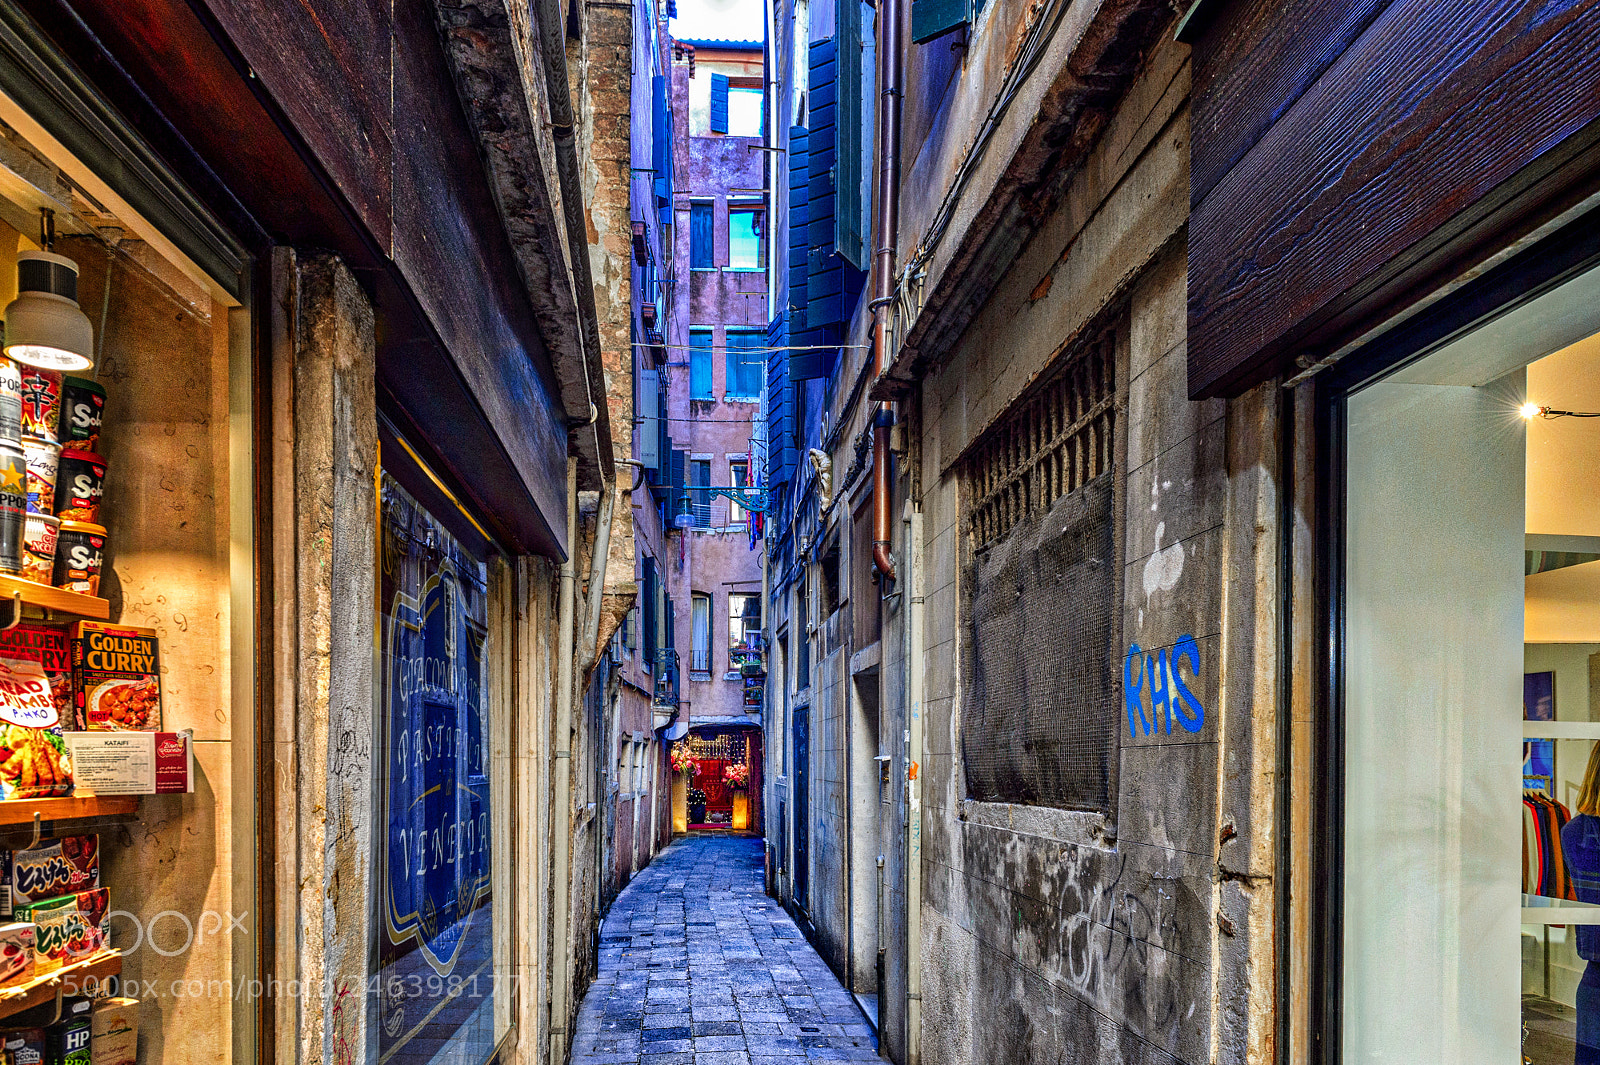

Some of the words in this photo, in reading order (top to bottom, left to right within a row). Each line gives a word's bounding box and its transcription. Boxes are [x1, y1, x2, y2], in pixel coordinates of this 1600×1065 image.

[89, 633, 152, 655] GOLDEN
[87, 650, 155, 673] CURRY
[1124, 633, 1204, 738] RHS
[399, 812, 488, 881] VENEZIA
[66, 1031, 90, 1050] HP
